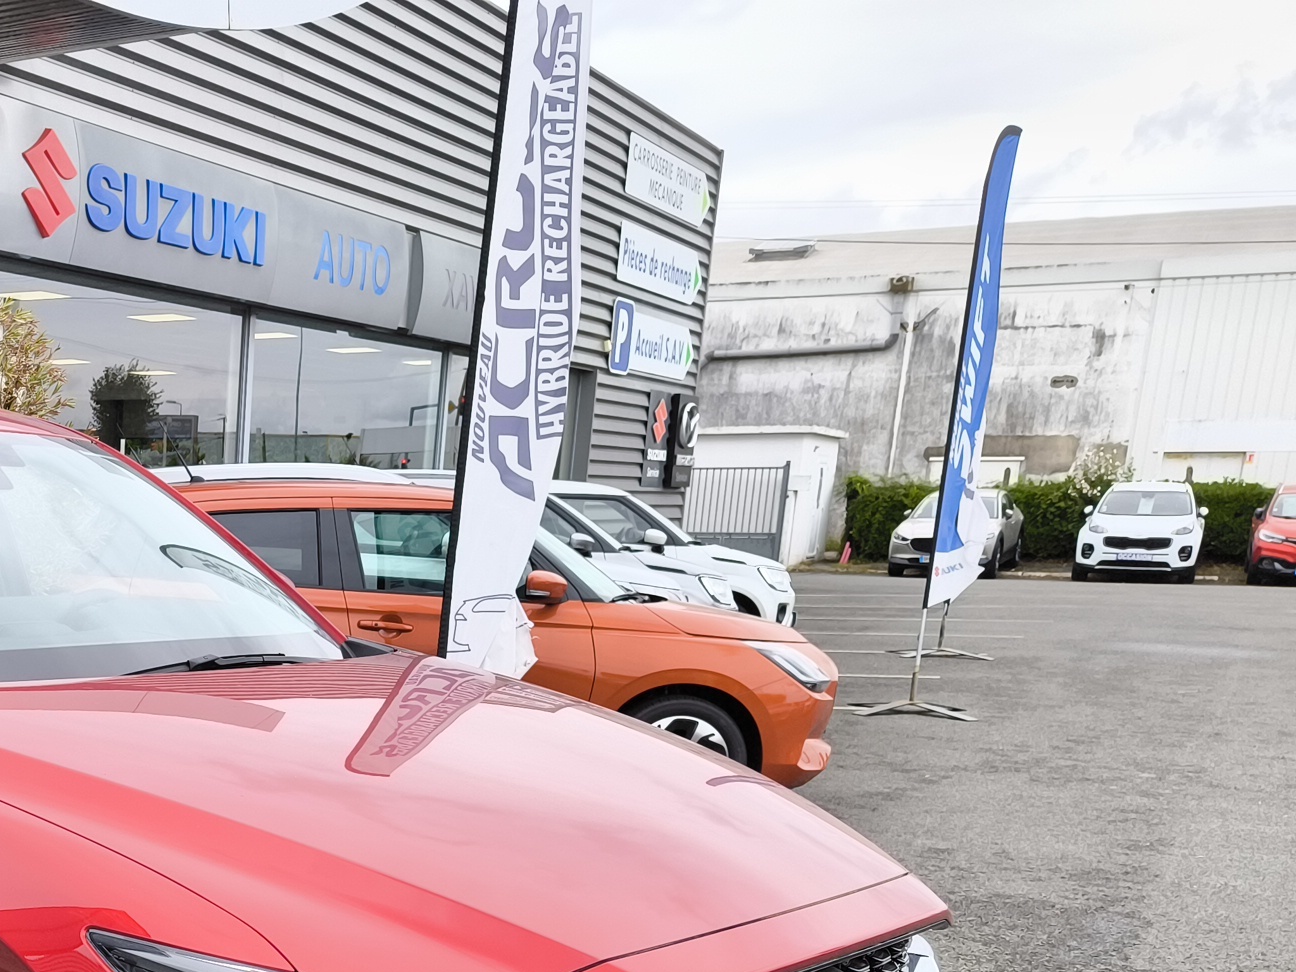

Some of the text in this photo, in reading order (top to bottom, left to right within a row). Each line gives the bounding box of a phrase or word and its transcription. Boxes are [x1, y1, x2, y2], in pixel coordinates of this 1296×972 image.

[632, 143, 702, 195] CARROSSERIE PEINTURE
[647, 178, 684, 211] MECANIQUE
[85, 163, 267, 267] SUZUKI
[313, 229, 392, 296] AUTO
[622, 237, 692, 295] Pièces de rechange
[537, 292, 570, 436] HYBRIDE
[614, 308, 629, 364] P
[634, 328, 664, 361] Accueil
[953, 232, 991, 481] SWIFT
[472, 332, 493, 464] NOUVEAU
